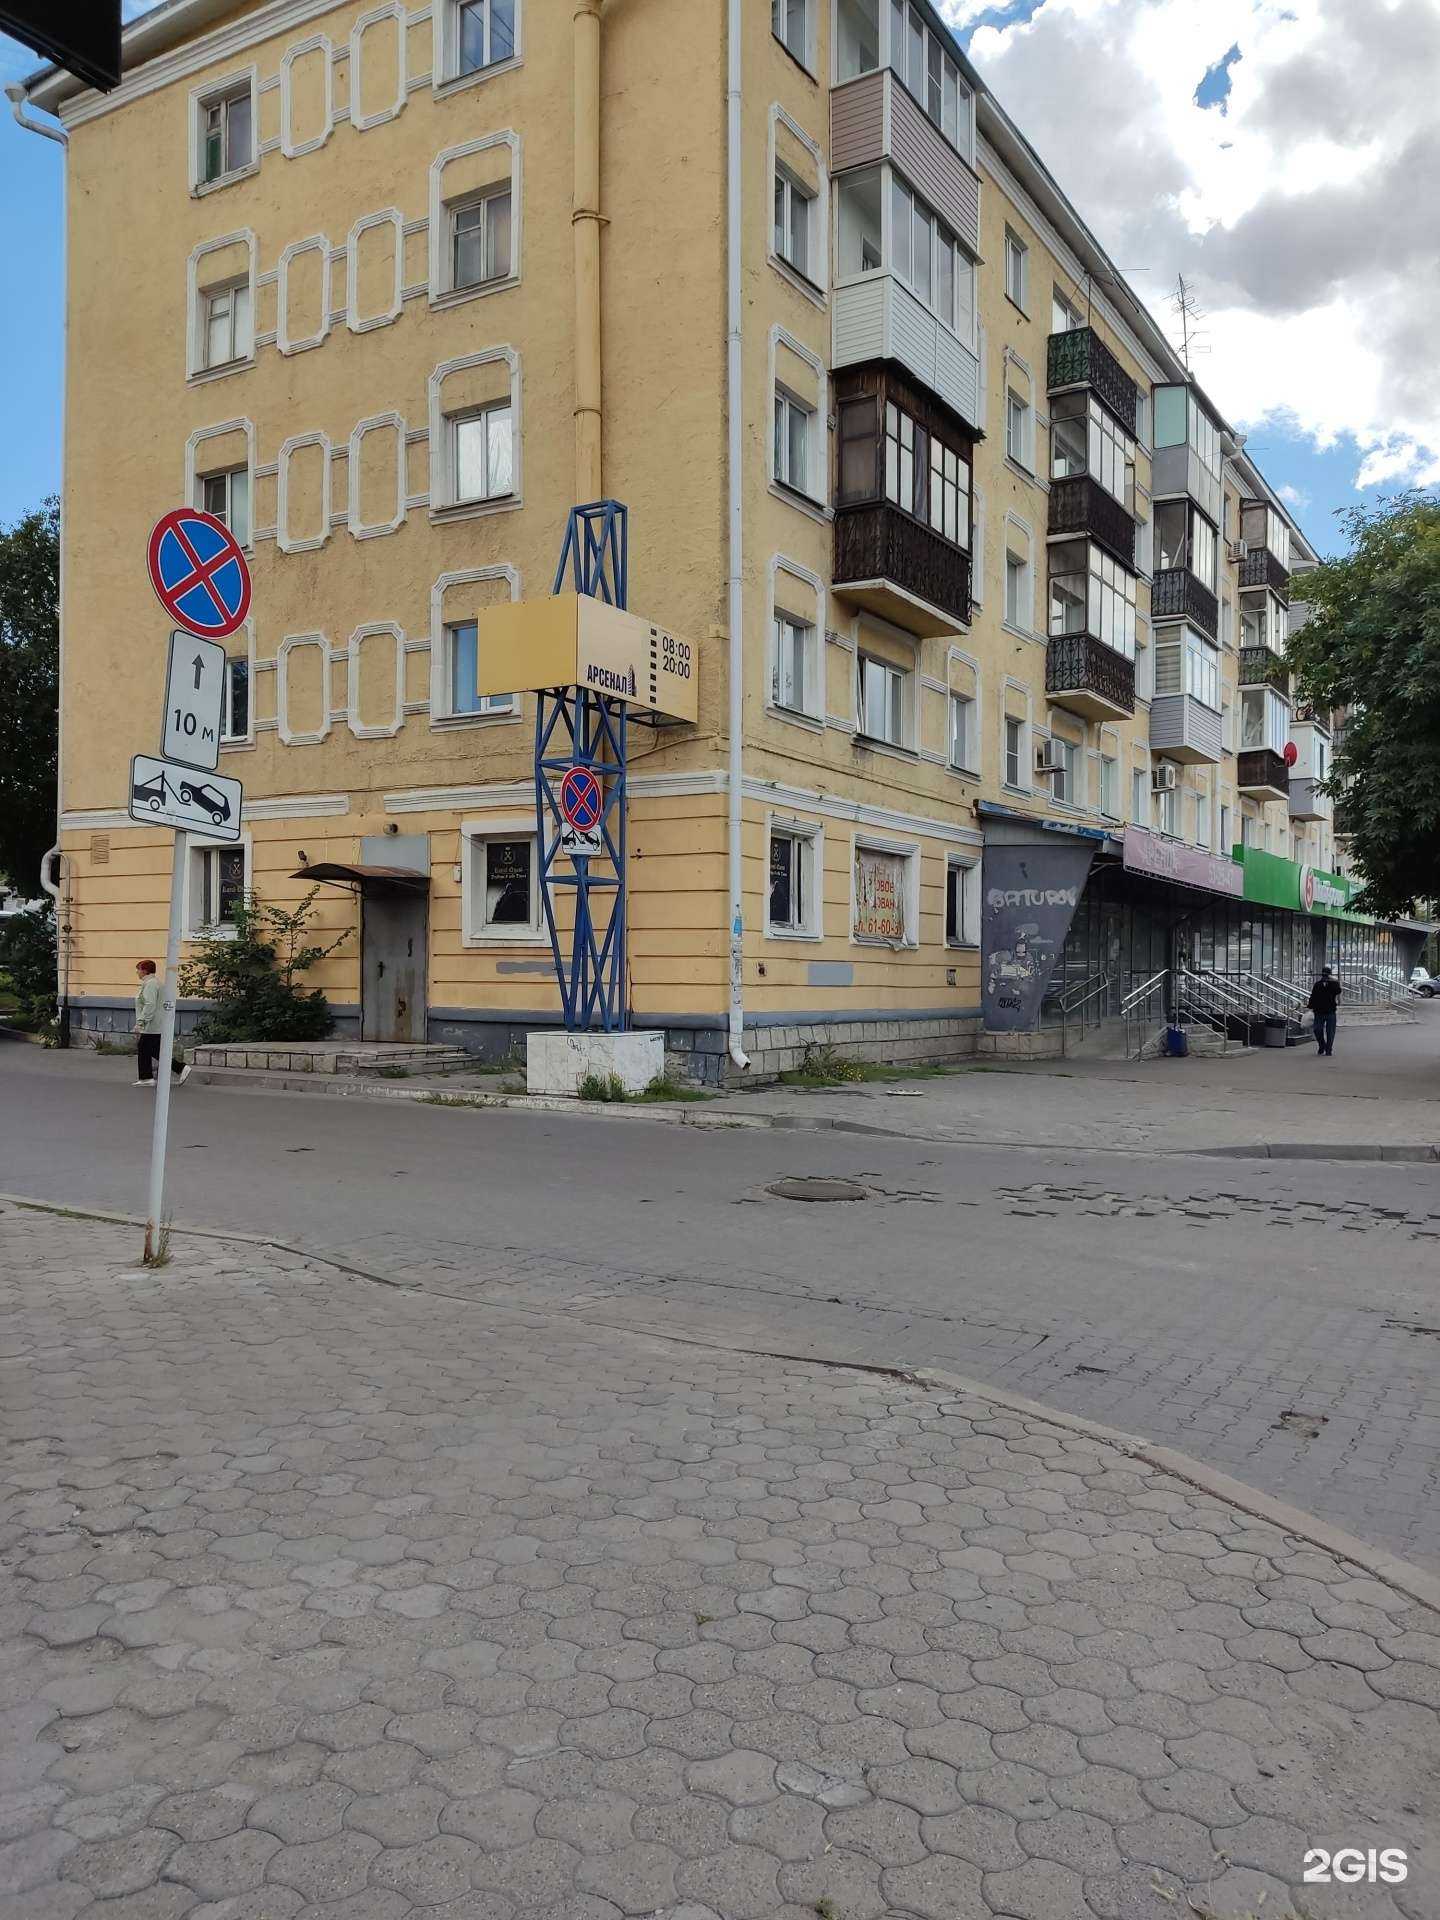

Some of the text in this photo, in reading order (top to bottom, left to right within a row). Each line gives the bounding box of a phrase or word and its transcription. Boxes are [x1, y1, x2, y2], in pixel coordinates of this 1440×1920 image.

[662, 636, 690, 660] 08:00
[587, 664, 627, 694] АРСЕНАЛ
[663, 655, 690, 679] 20:00
[174, 709, 197, 736] 10
